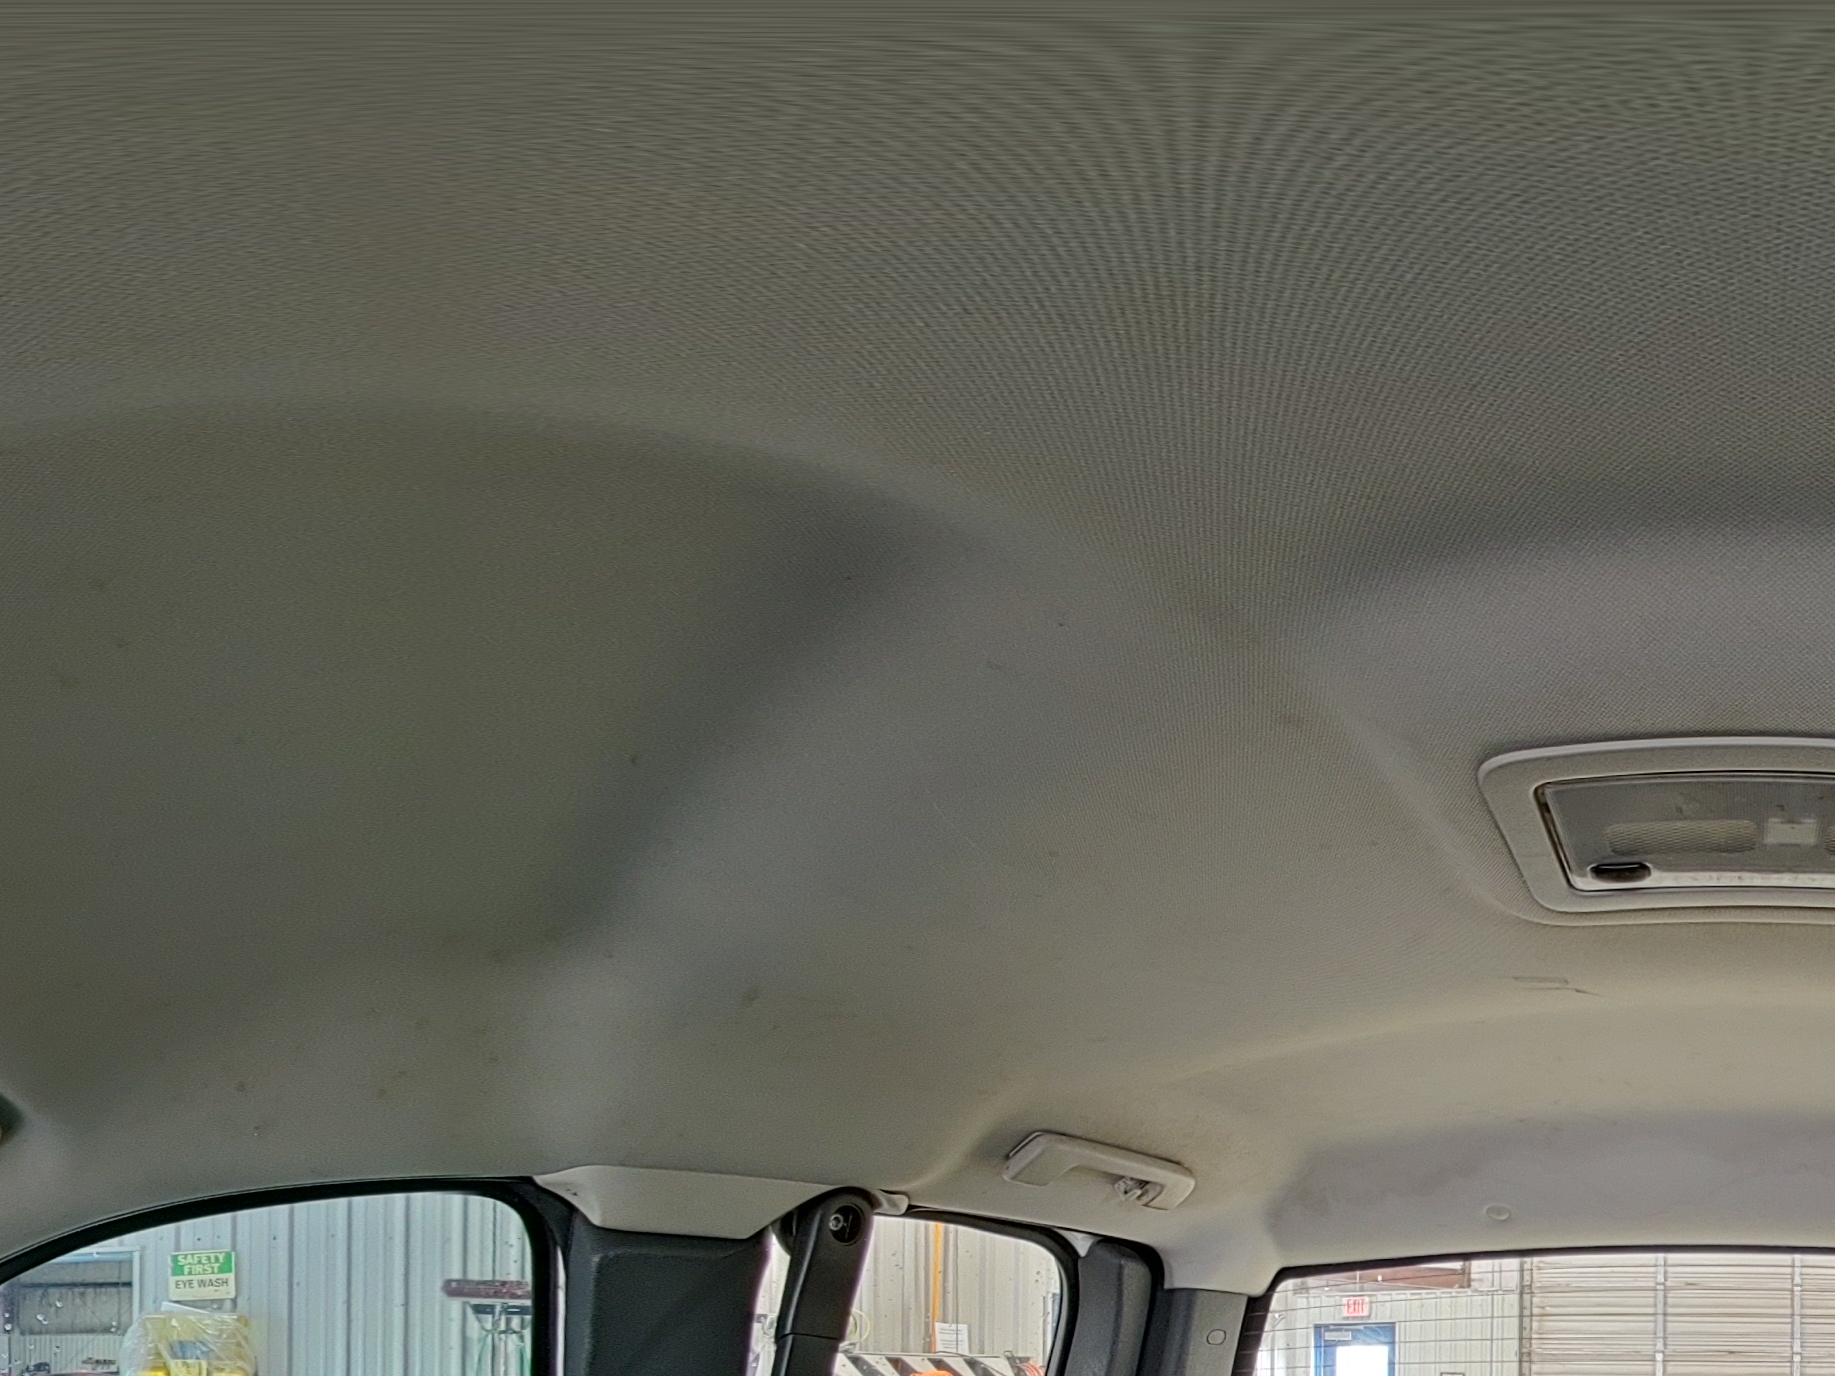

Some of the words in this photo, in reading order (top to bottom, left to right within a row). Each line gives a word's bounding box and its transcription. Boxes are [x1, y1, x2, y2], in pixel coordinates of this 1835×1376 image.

[177, 1253, 227, 1265] SAFETY
[183, 1264, 221, 1275] FIRST
[175, 1279, 196, 1290] EYE
[197, 1277, 229, 1288] WASH
[1346, 1298, 1366, 1316] EXIT
